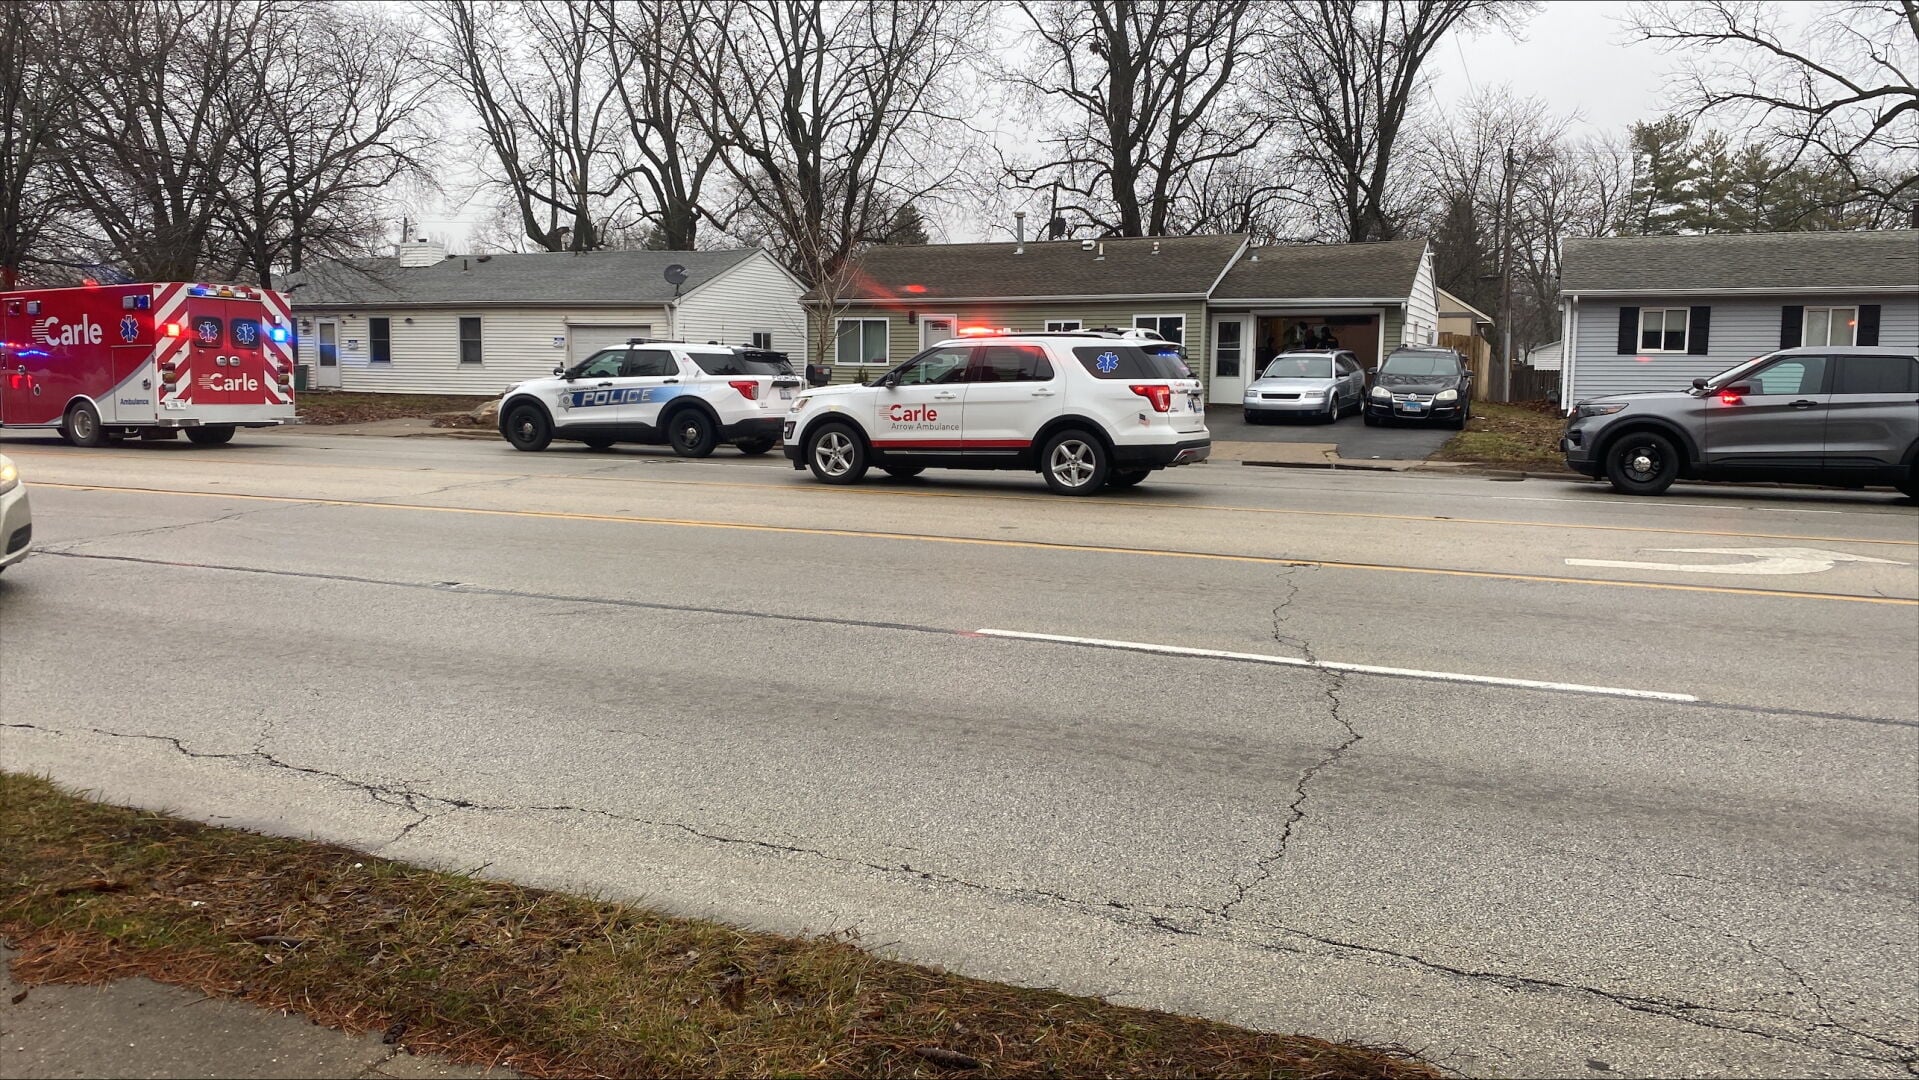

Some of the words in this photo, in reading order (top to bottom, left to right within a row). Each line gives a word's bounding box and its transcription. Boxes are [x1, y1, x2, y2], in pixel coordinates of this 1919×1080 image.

[32, 314, 103, 346] Carle
[199, 373, 258, 391] Carle
[120, 397, 149, 405] Ambulance
[581, 388, 655, 406] POLICE
[879, 403, 938, 422] Carle
[891, 422, 914, 431] Arrow
[916, 422, 960, 431] Ambulance
